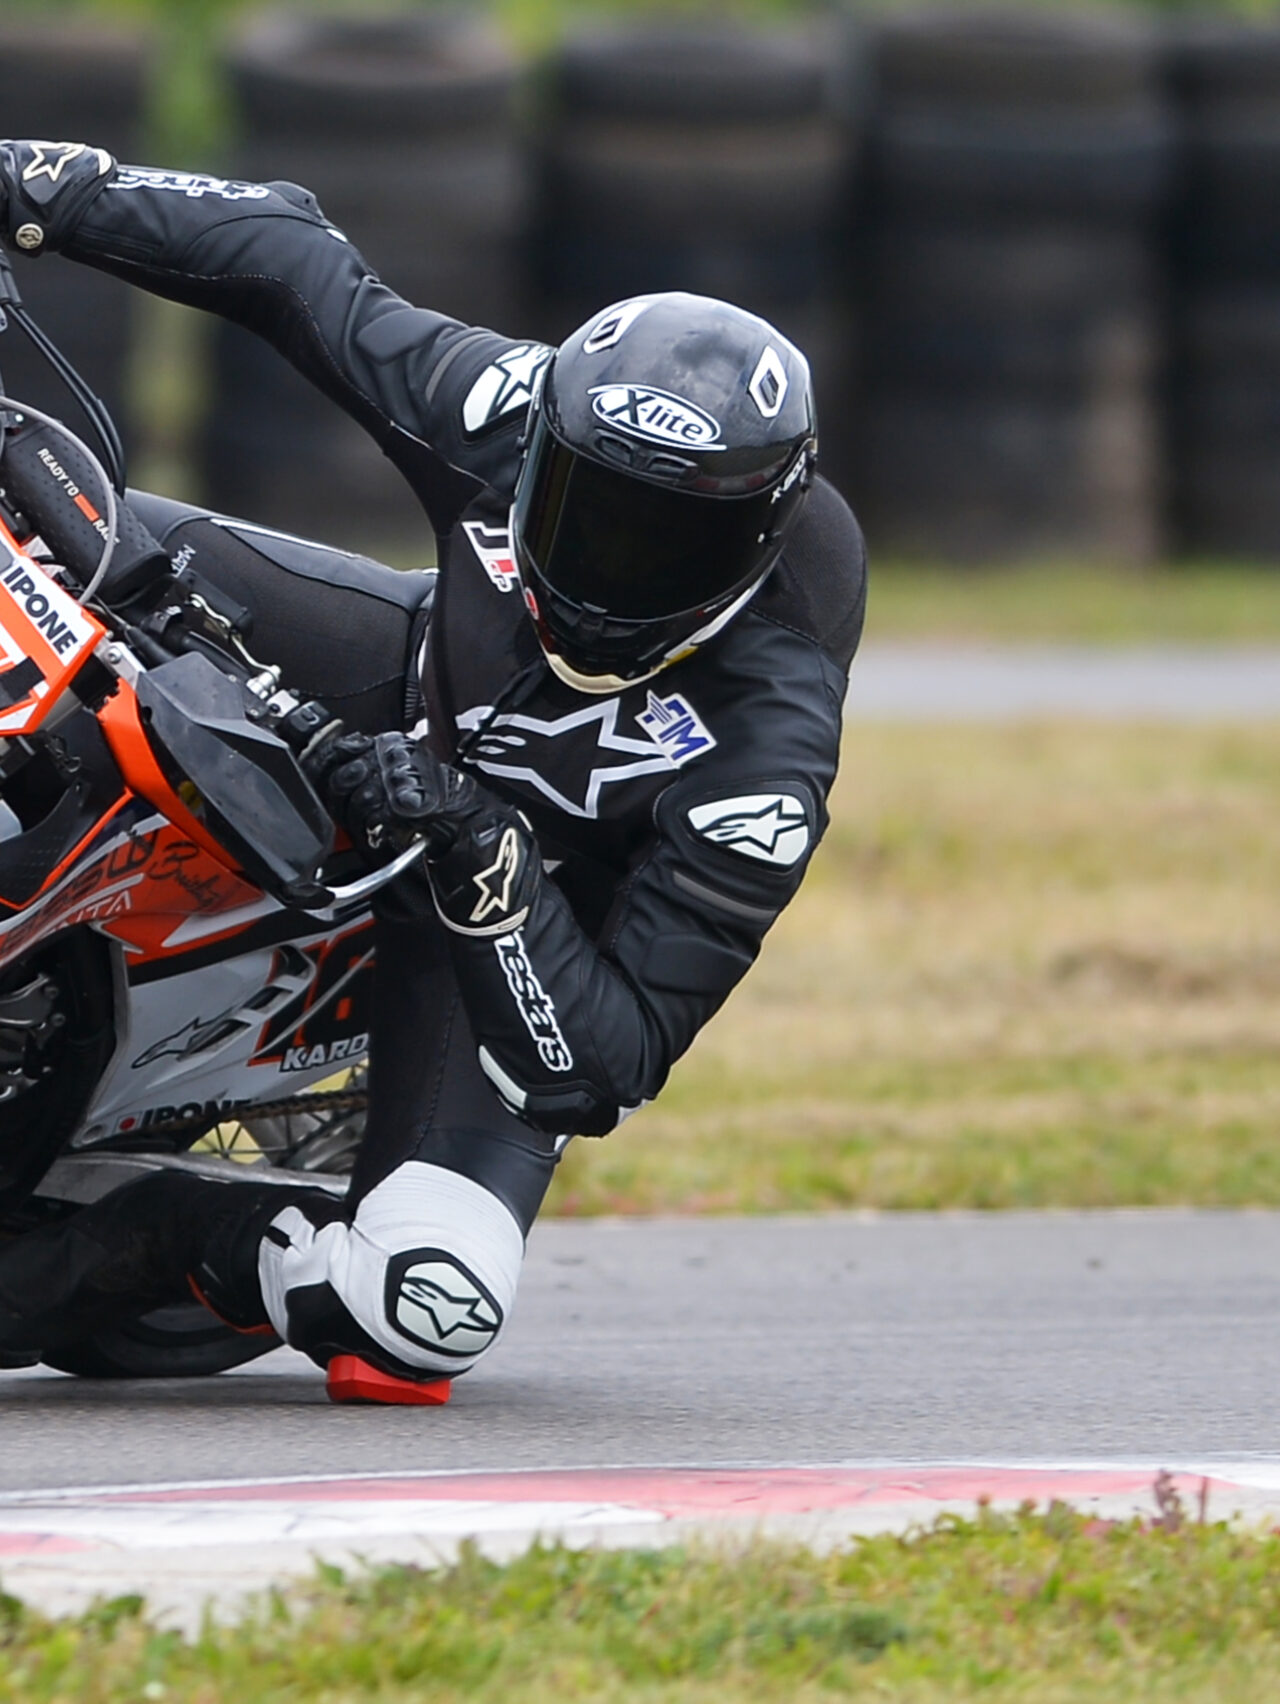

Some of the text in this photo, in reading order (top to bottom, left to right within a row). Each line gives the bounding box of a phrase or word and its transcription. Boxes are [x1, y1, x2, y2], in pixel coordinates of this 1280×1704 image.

[604, 388, 704, 442] X-lite
[37, 447, 69, 485] READY
[63, 477, 80, 497] TO
[2, 565, 78, 656] IPONE
[279, 1032, 370, 1073] KARD
